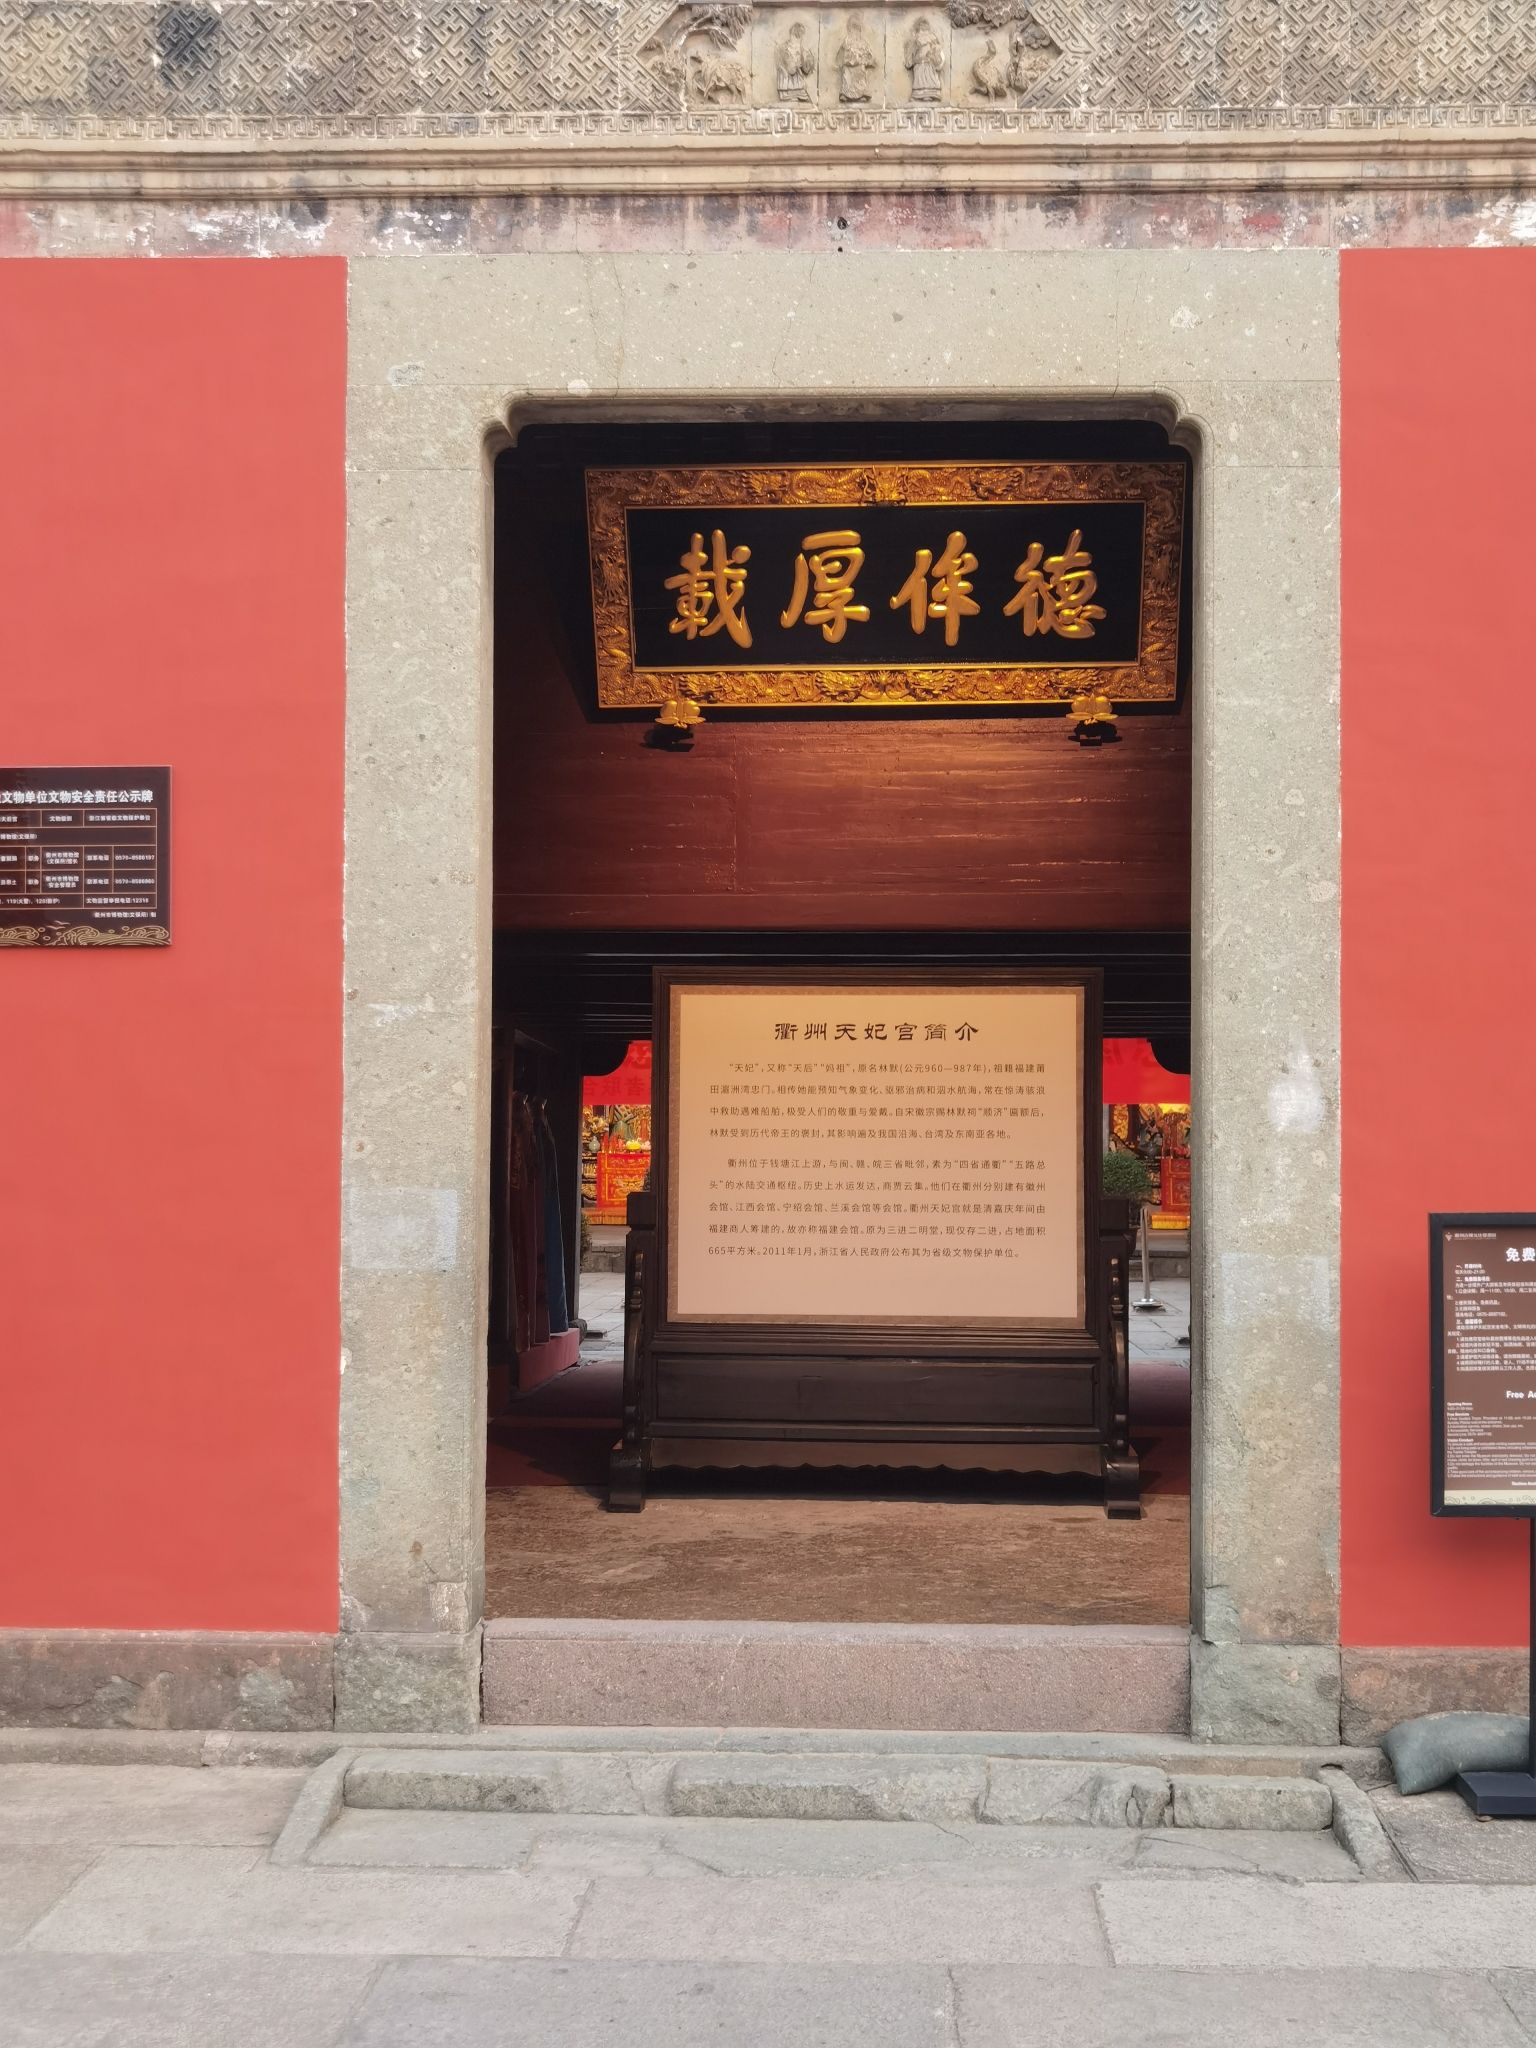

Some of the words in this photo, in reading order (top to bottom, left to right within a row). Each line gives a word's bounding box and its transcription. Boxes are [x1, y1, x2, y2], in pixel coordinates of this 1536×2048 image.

[0, 790, 153, 804] 文物单位文物安全责任公示牌
[774, 1021, 979, 1041] 衢州天妃宫简介
[1506, 1247, 1536, 1262] 免费
[1506, 1391, 1524, 1399] Free
